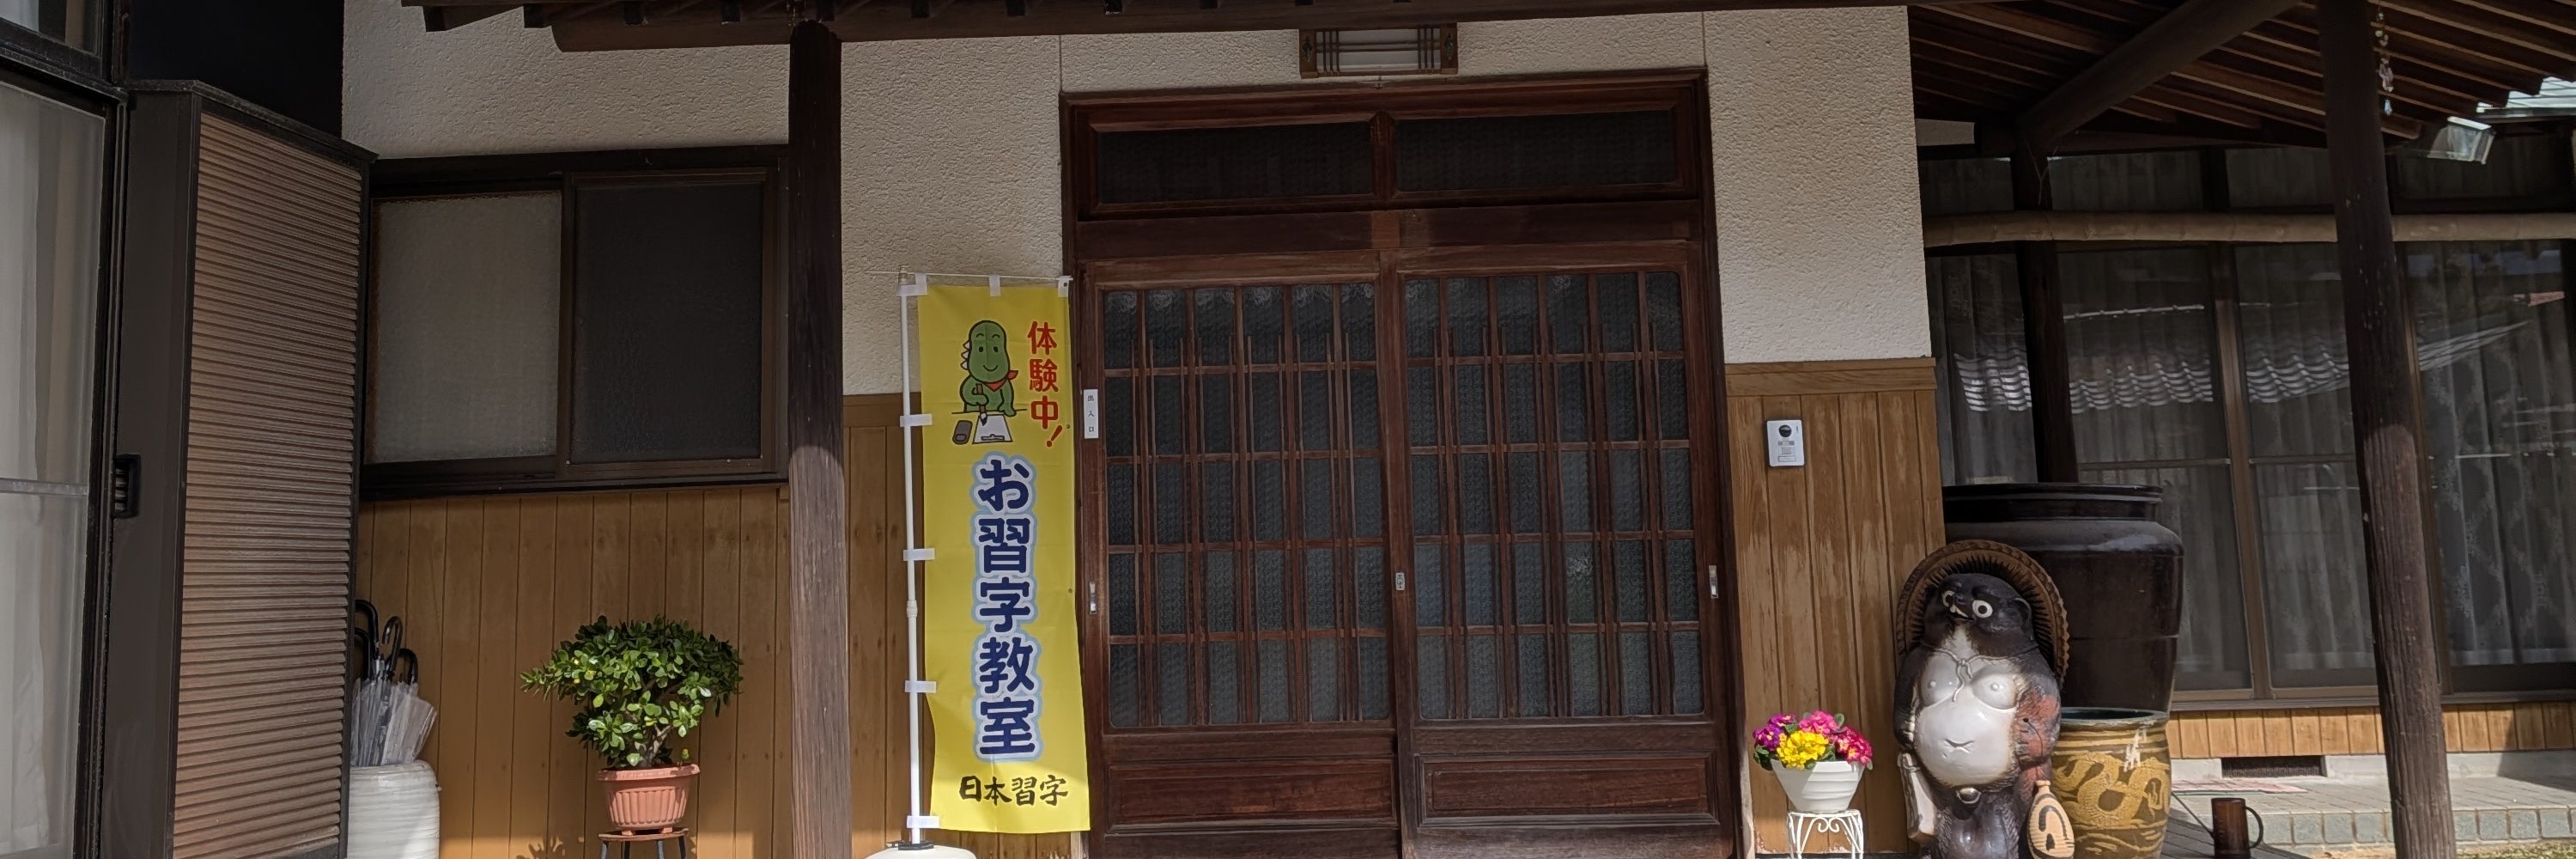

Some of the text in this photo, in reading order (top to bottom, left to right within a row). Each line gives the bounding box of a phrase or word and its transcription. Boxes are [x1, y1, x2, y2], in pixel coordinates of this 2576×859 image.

[977, 459, 1036, 756] お習字教室
[958, 774, 1069, 807] 日本習字
